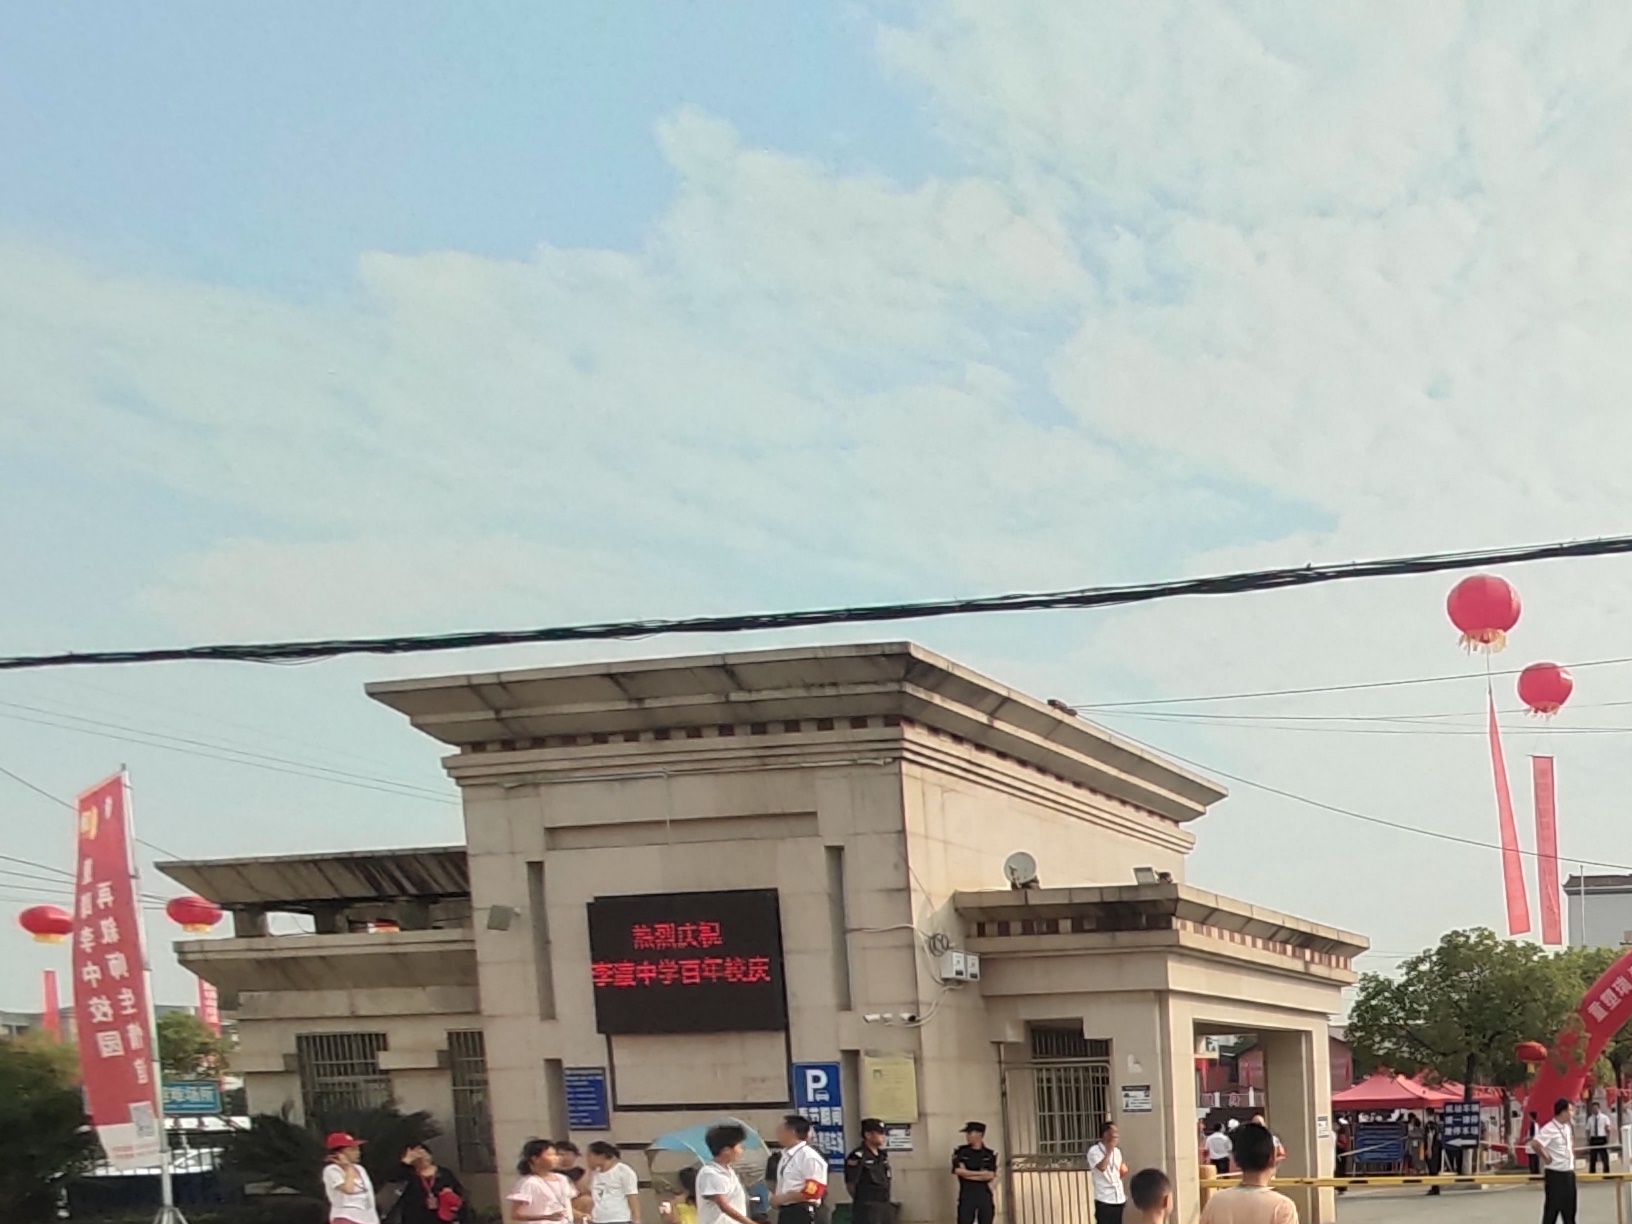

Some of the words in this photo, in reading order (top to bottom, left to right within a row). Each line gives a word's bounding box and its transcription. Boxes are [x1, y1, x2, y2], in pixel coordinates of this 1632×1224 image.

[631, 921, 724, 950] 热烈庆祝
[592, 955, 771, 987] 李渡中学百年校庆
[805, 1068, 828, 1103] P
